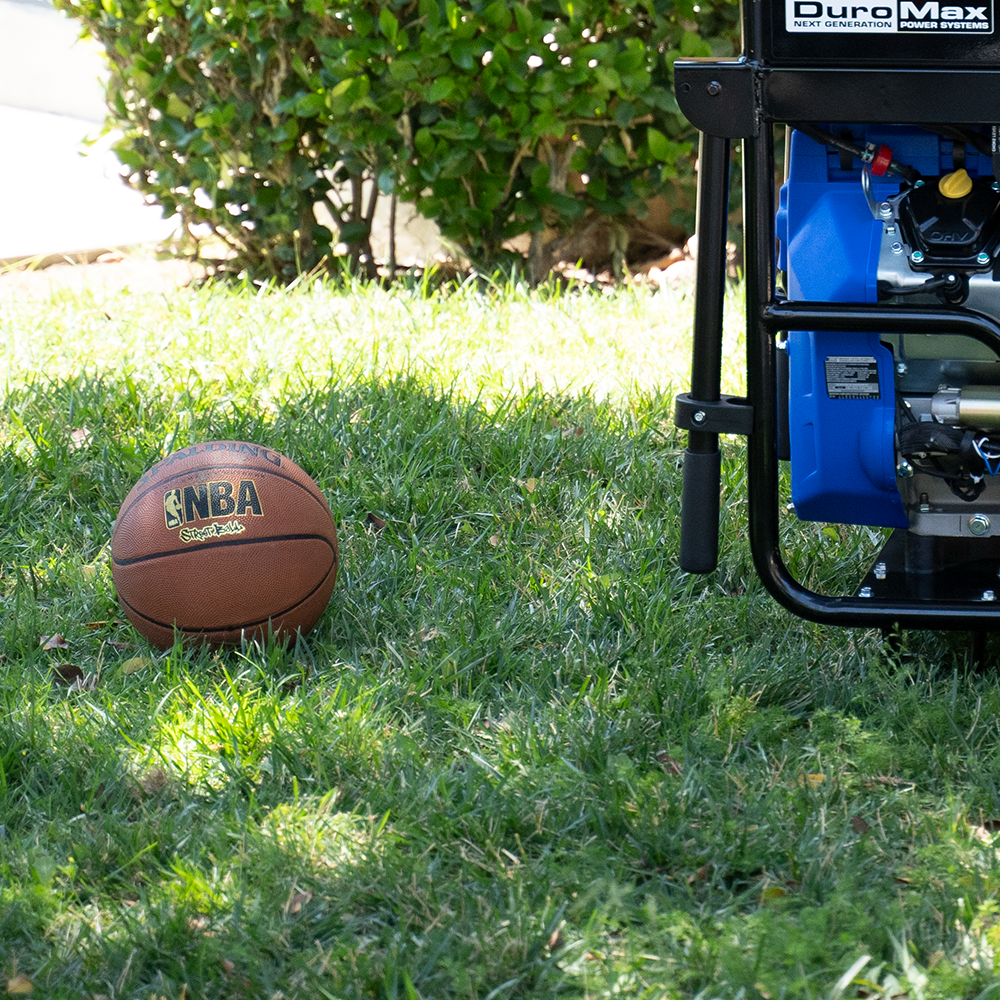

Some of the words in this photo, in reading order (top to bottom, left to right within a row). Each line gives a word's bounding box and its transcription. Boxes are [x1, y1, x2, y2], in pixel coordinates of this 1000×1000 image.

[900, 21, 938, 29] POWER
[940, 22, 989, 30] SYSTEMS
[183, 479, 264, 524] NBA
